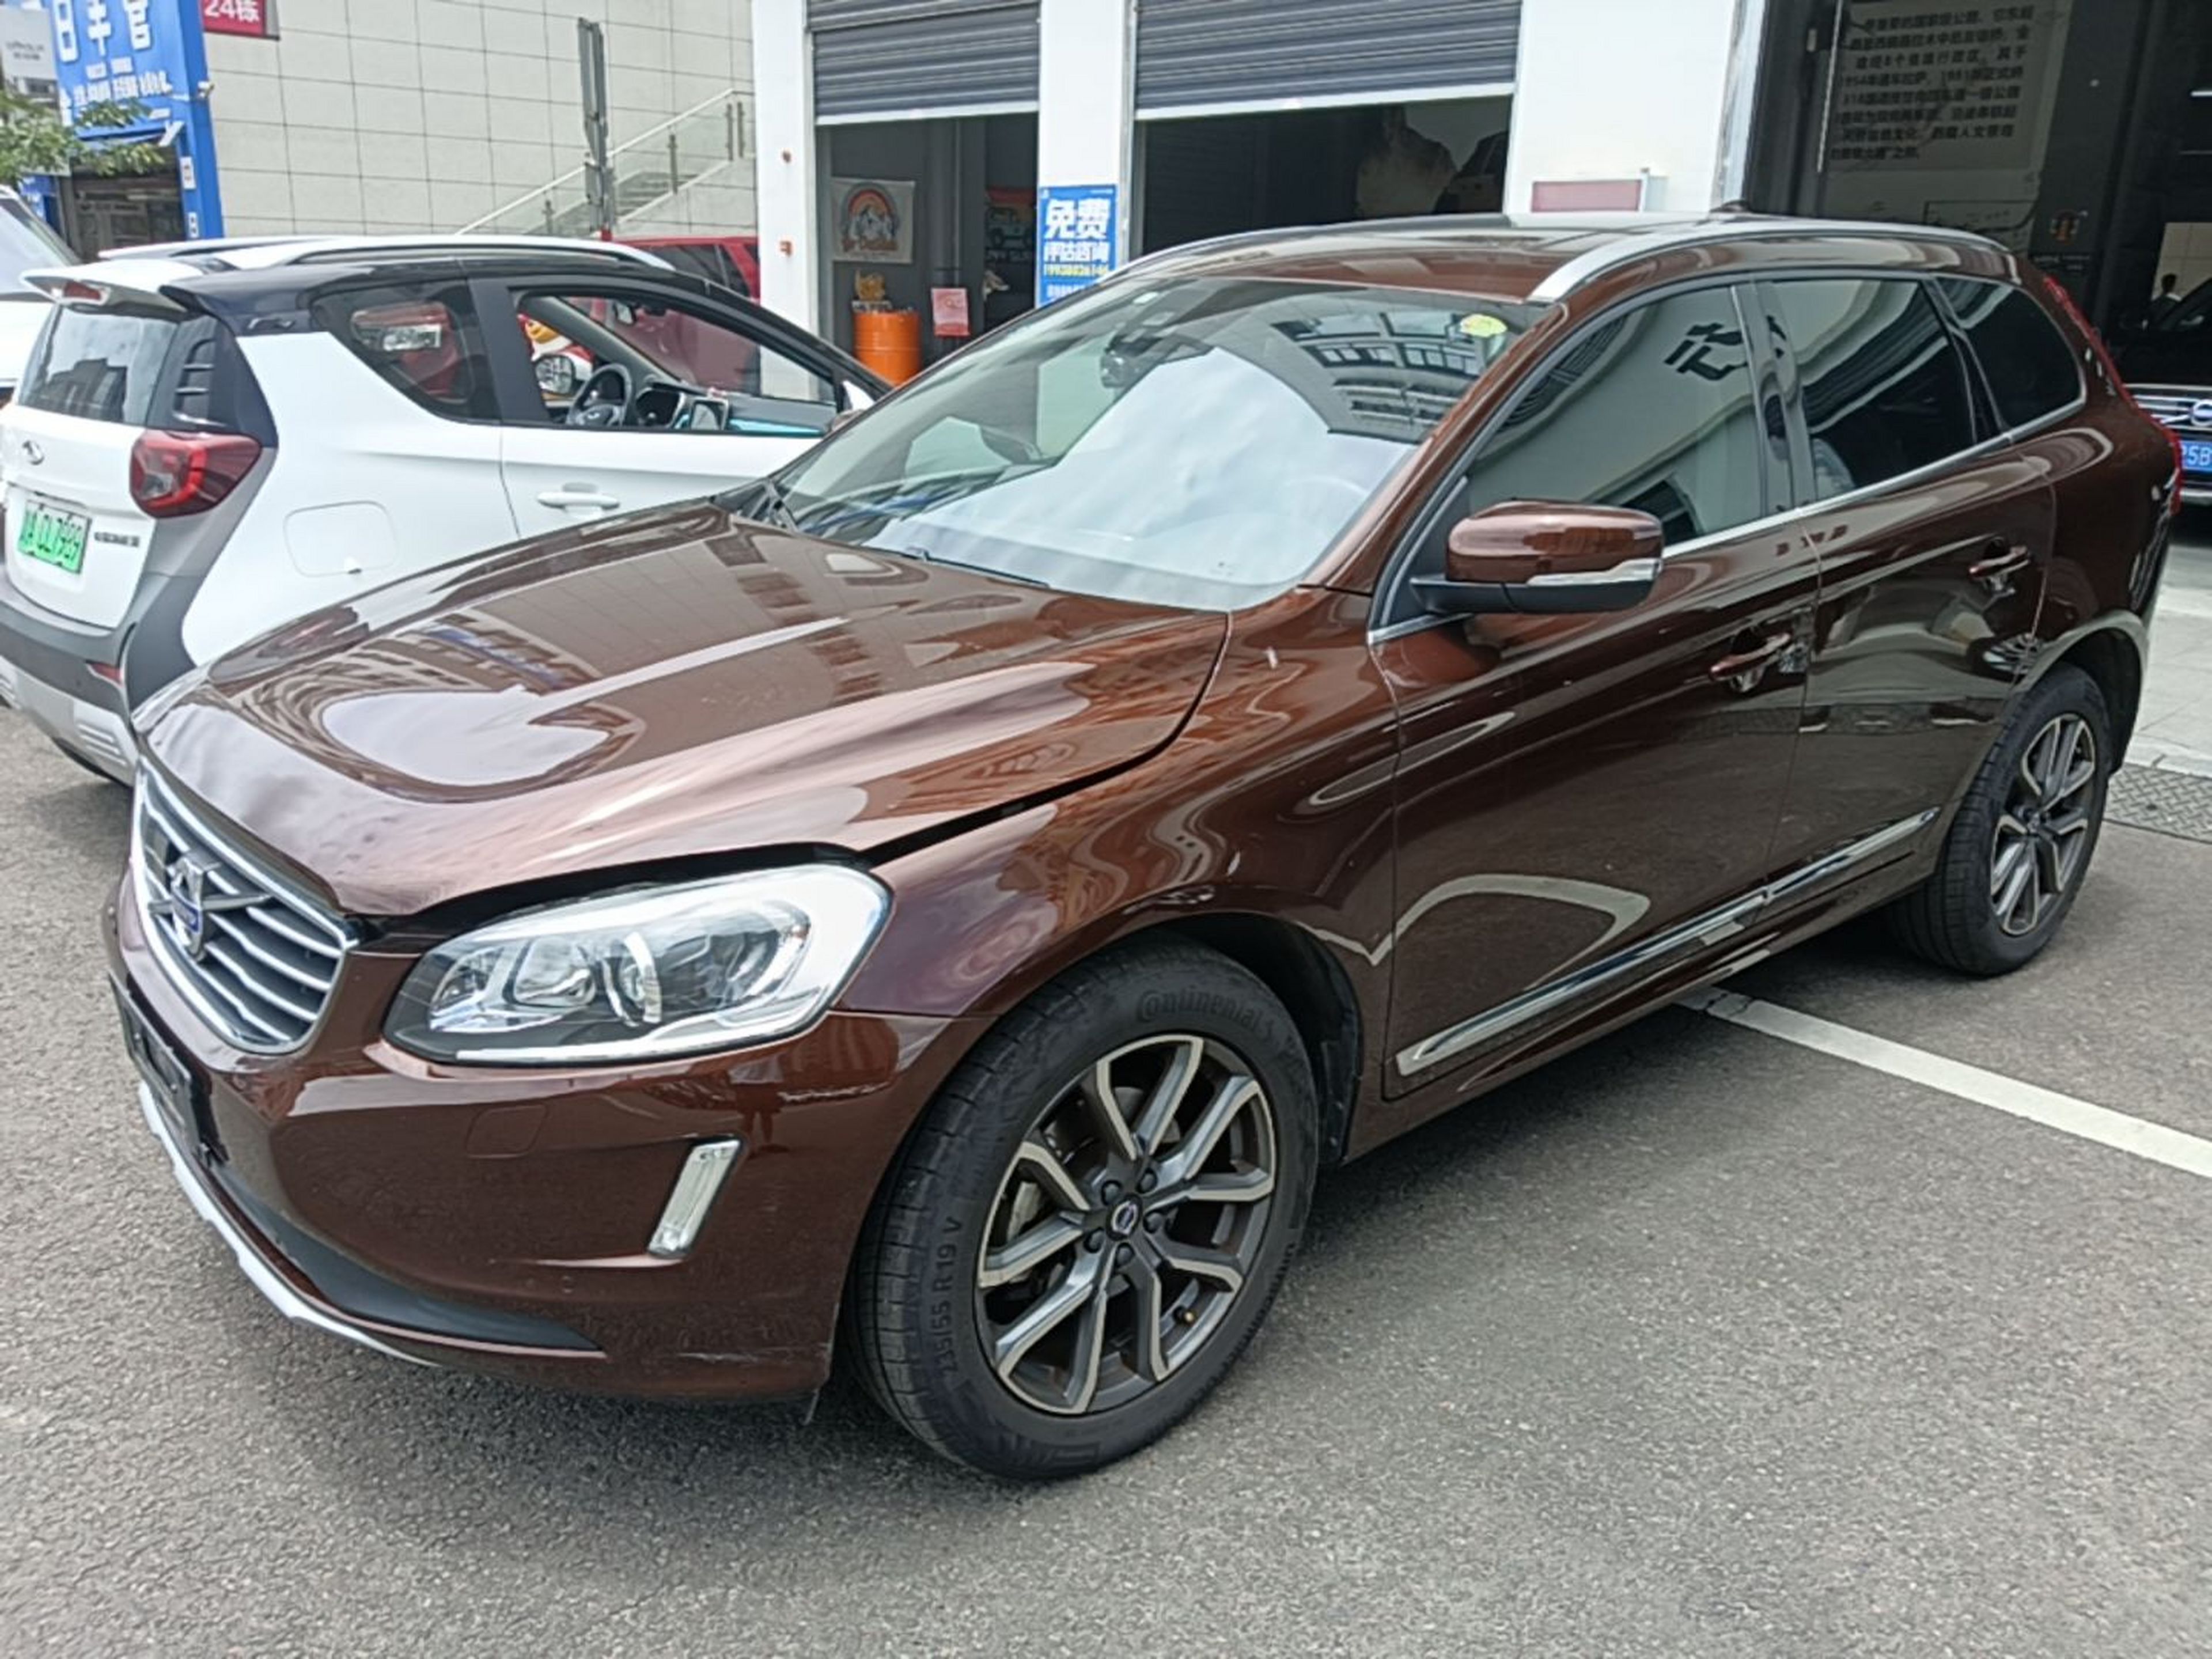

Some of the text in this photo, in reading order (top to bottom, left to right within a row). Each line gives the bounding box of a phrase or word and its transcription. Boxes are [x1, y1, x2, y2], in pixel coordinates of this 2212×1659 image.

[1044, 198, 1111, 240] 免费
[943, 1216, 962, 1233] V
[936, 1244, 956, 1269] 19
[934, 1275, 953, 1292] R
